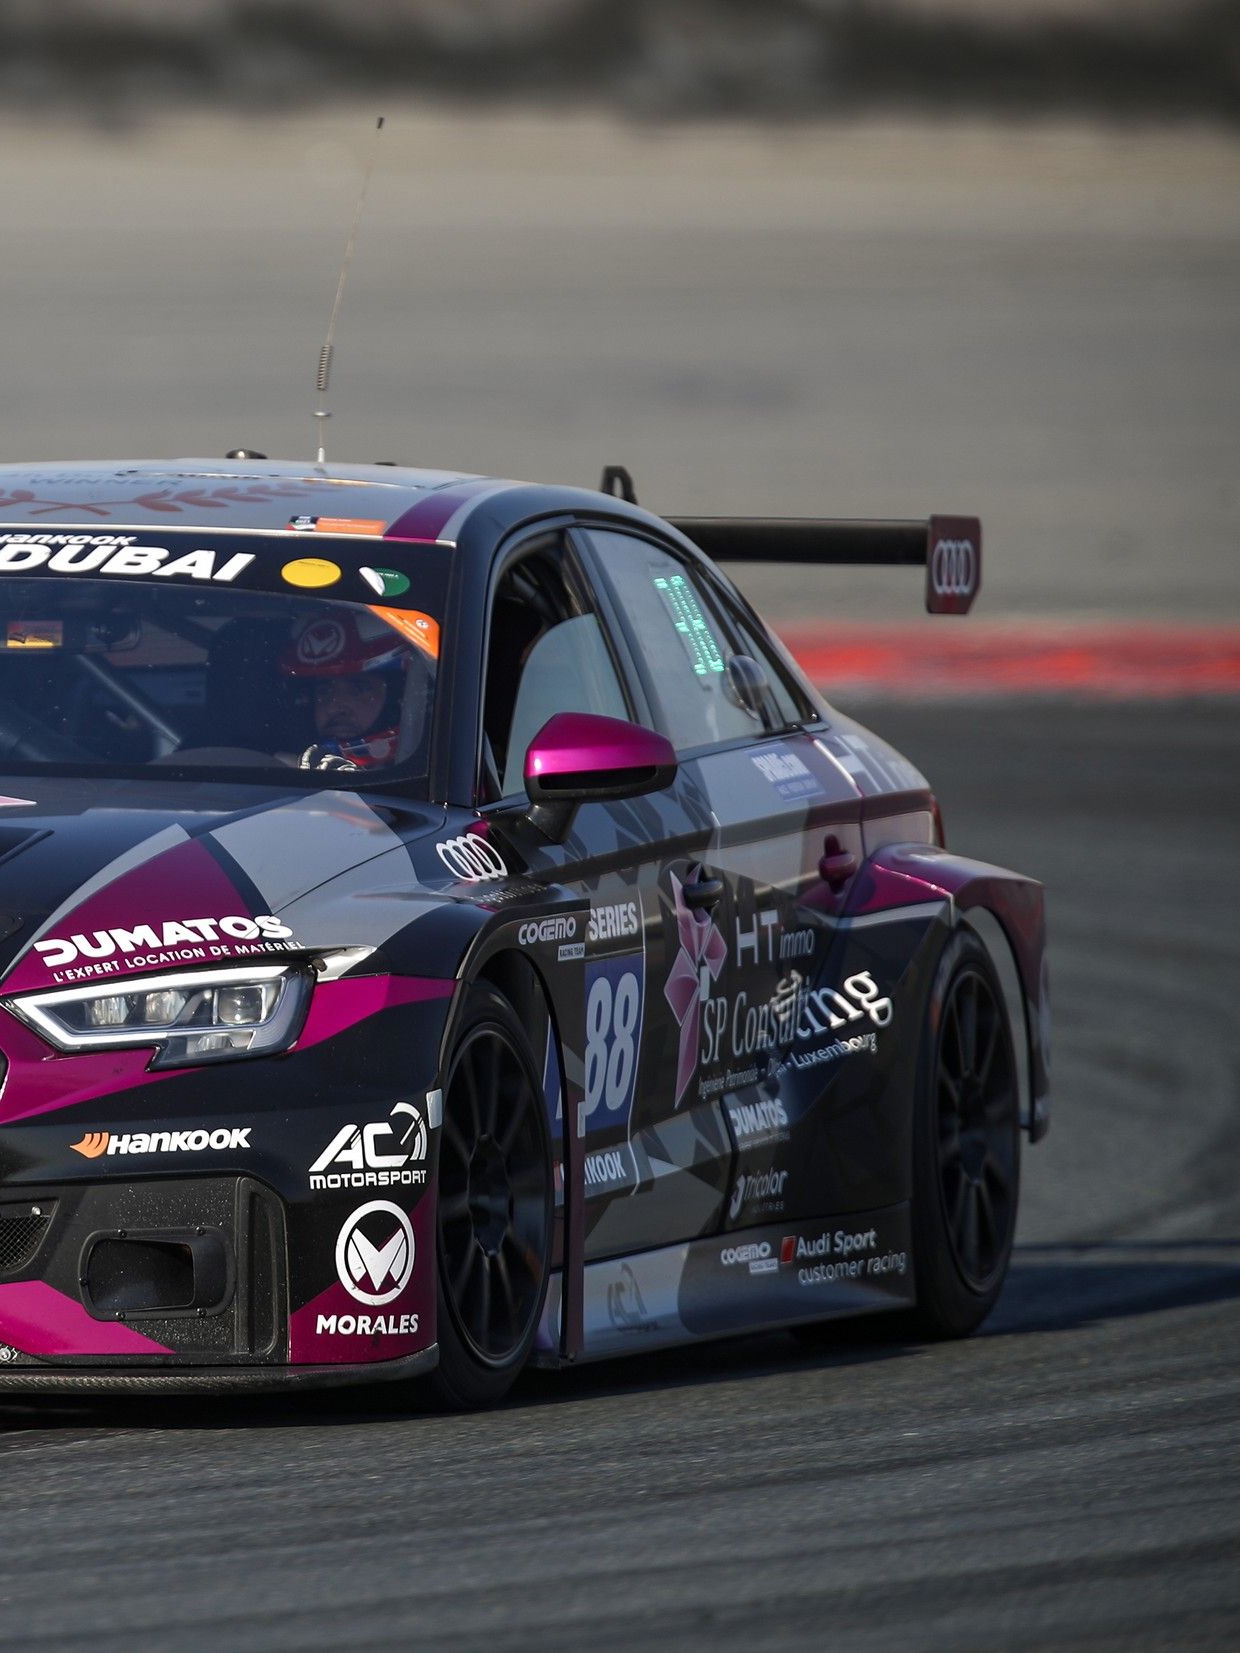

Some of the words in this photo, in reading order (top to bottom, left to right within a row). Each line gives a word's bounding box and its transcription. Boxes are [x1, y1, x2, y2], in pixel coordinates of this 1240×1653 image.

[518, 916, 577, 945] COGEMO
[589, 902, 638, 941] SERIES
[33, 915, 293, 968] DUMATOS
[53, 960, 121, 983] L'EXPERT
[124, 948, 206, 969] LOCATION
[210, 945, 231, 956] DE
[235, 941, 306, 955] MATÉRIEL
[556, 972, 640, 1120] 88
[701, 996, 728, 1065] SP
[790, 1032, 878, 1068] Luxembourg
[309, 1169, 427, 1190] MOTORSPORT
[796, 1233, 831, 1257] Audi
[834, 1228, 877, 1255] Sport
[798, 1258, 863, 1286] customer
[867, 1252, 907, 1274] racing
[315, 1313, 419, 1336] MORALES
